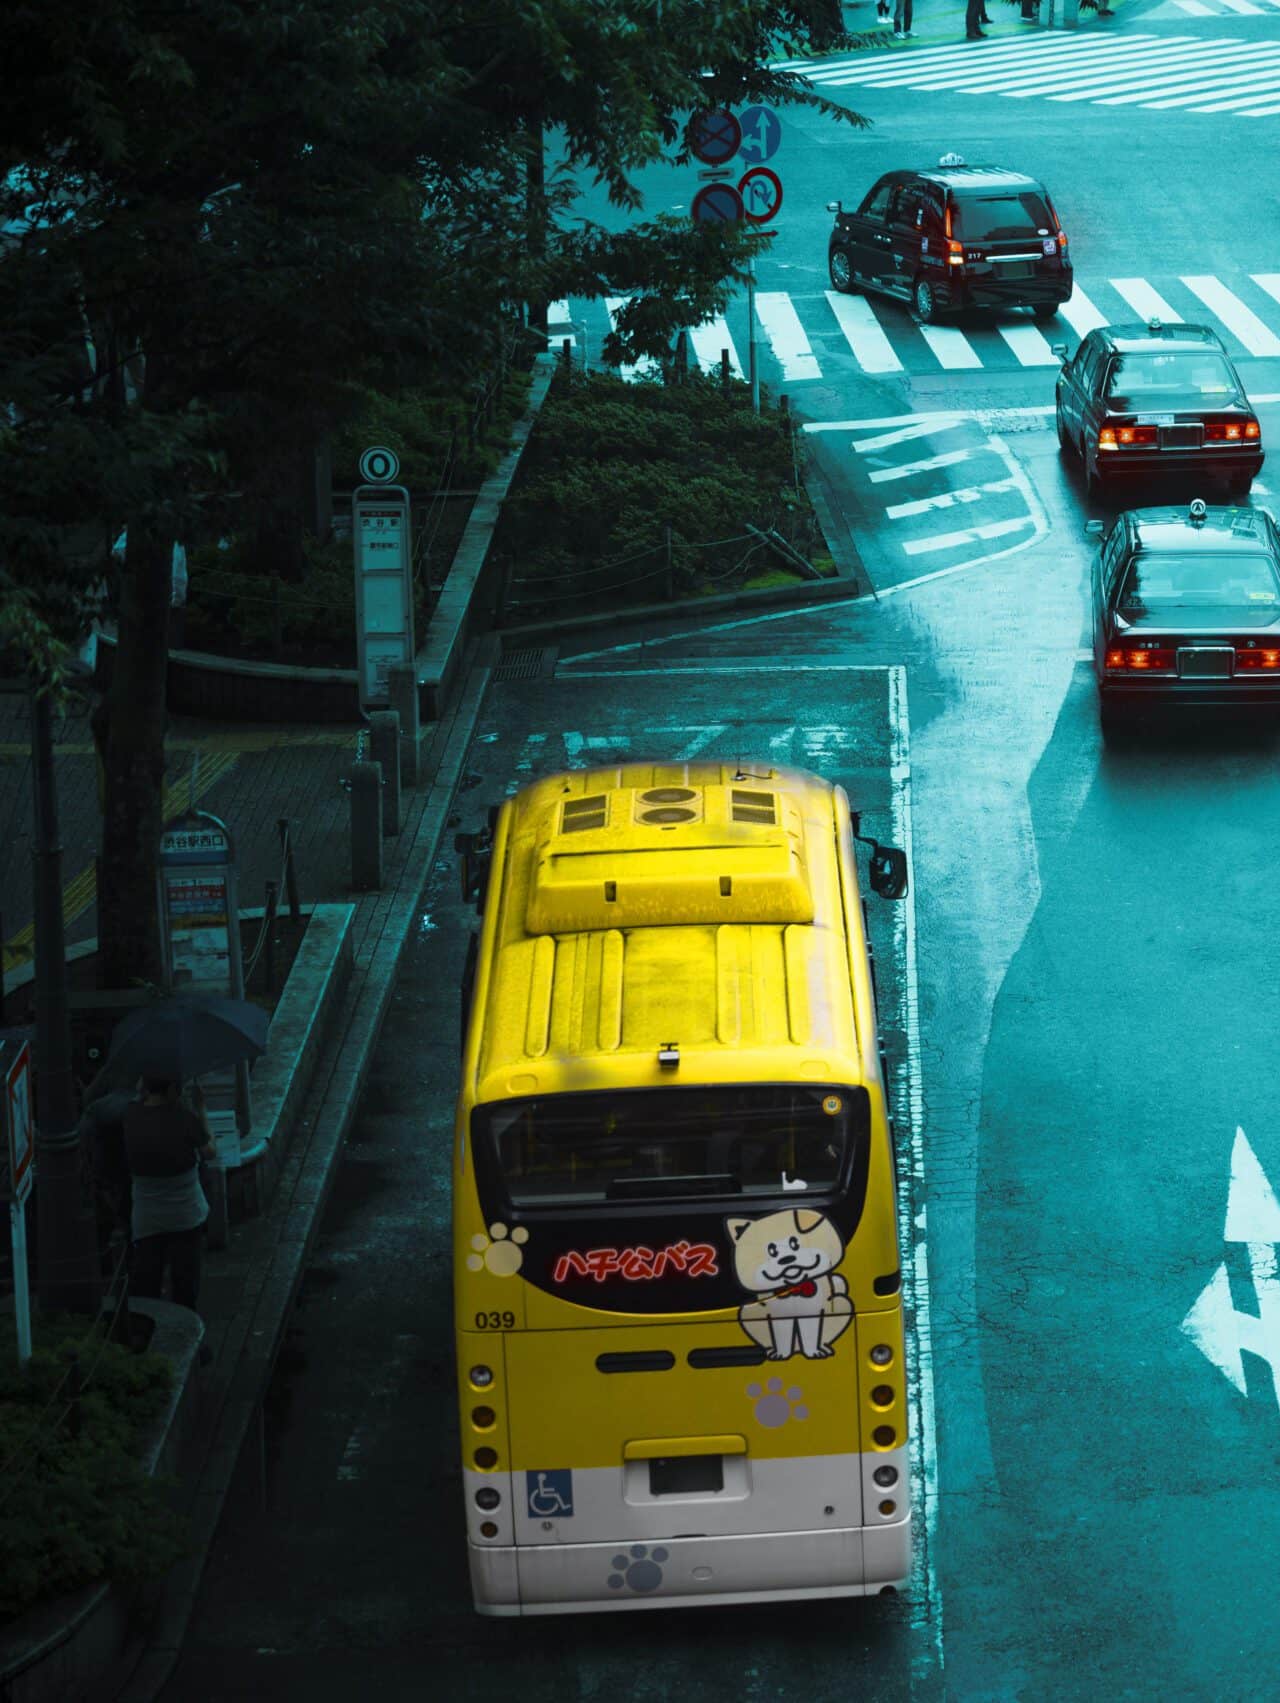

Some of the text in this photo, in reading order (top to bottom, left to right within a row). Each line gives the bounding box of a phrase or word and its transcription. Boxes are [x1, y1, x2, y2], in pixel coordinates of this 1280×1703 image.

[164, 834, 224, 849] 渋谷駅西口
[554, 1240, 719, 1283] ハチ公バス
[475, 1312, 515, 1330] 039
